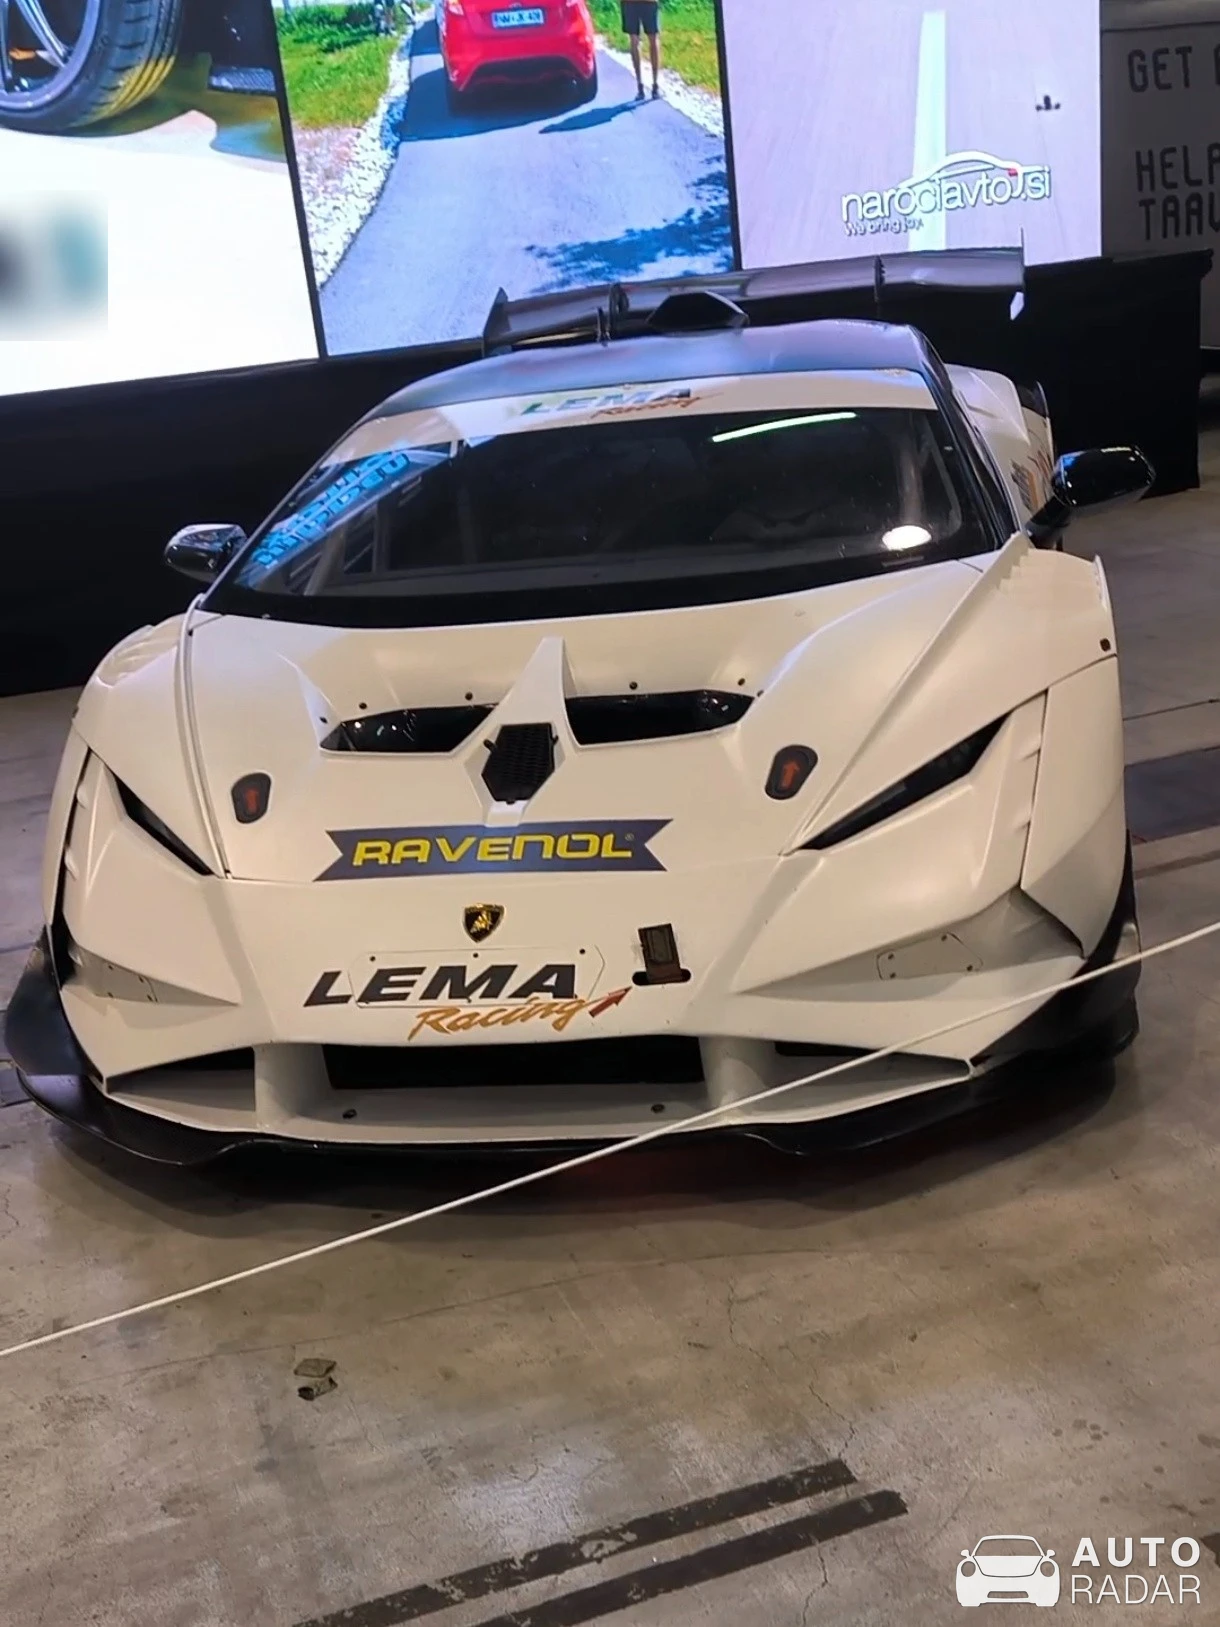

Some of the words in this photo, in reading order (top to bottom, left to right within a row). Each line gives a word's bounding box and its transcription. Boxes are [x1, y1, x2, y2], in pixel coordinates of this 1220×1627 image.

[1127, 46, 1192, 92] GET
[520, 387, 692, 416] LEMA
[351, 832, 633, 867] RAVENOL
[303, 963, 577, 1007] LEMA
[407, 995, 598, 1042] Racing
